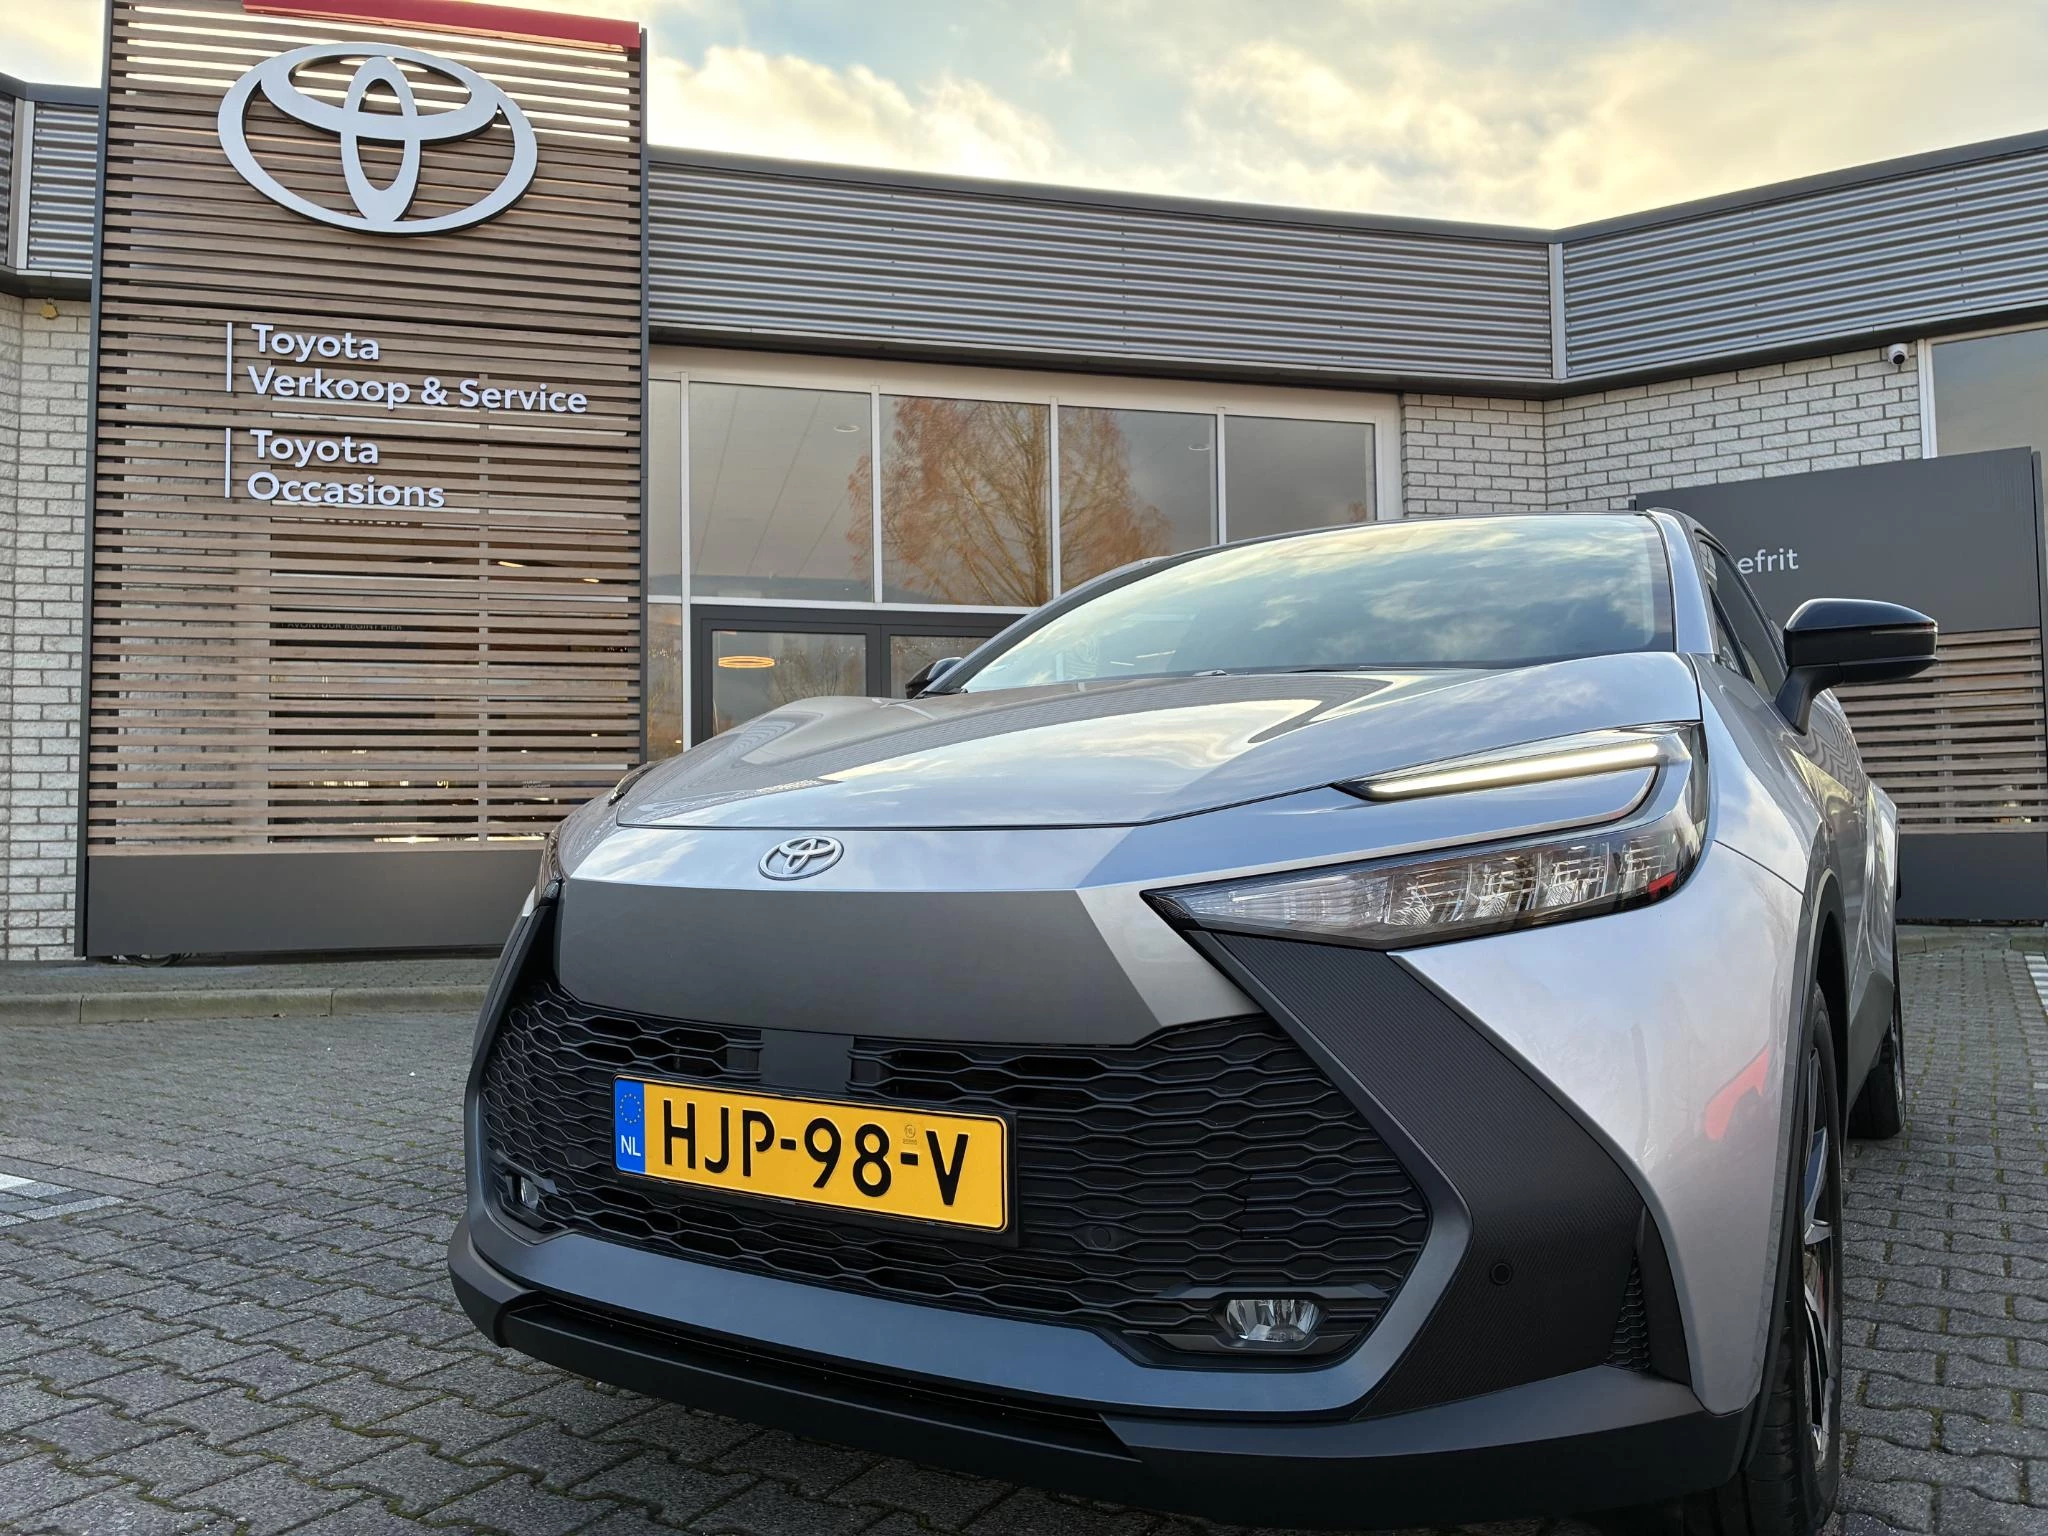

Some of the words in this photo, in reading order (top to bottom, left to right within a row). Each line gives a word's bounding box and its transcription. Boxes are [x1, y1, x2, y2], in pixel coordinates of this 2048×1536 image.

[250, 323, 381, 363] Toyota
[247, 366, 411, 410] Verkoop
[421, 376, 449, 406] &
[459, 378, 588, 414] Service
[249, 428, 380, 468] Toyota
[247, 471, 446, 509] Occasions
[620, 1134, 642, 1157] NL
[662, 1098, 970, 1206] HJP-98-V
